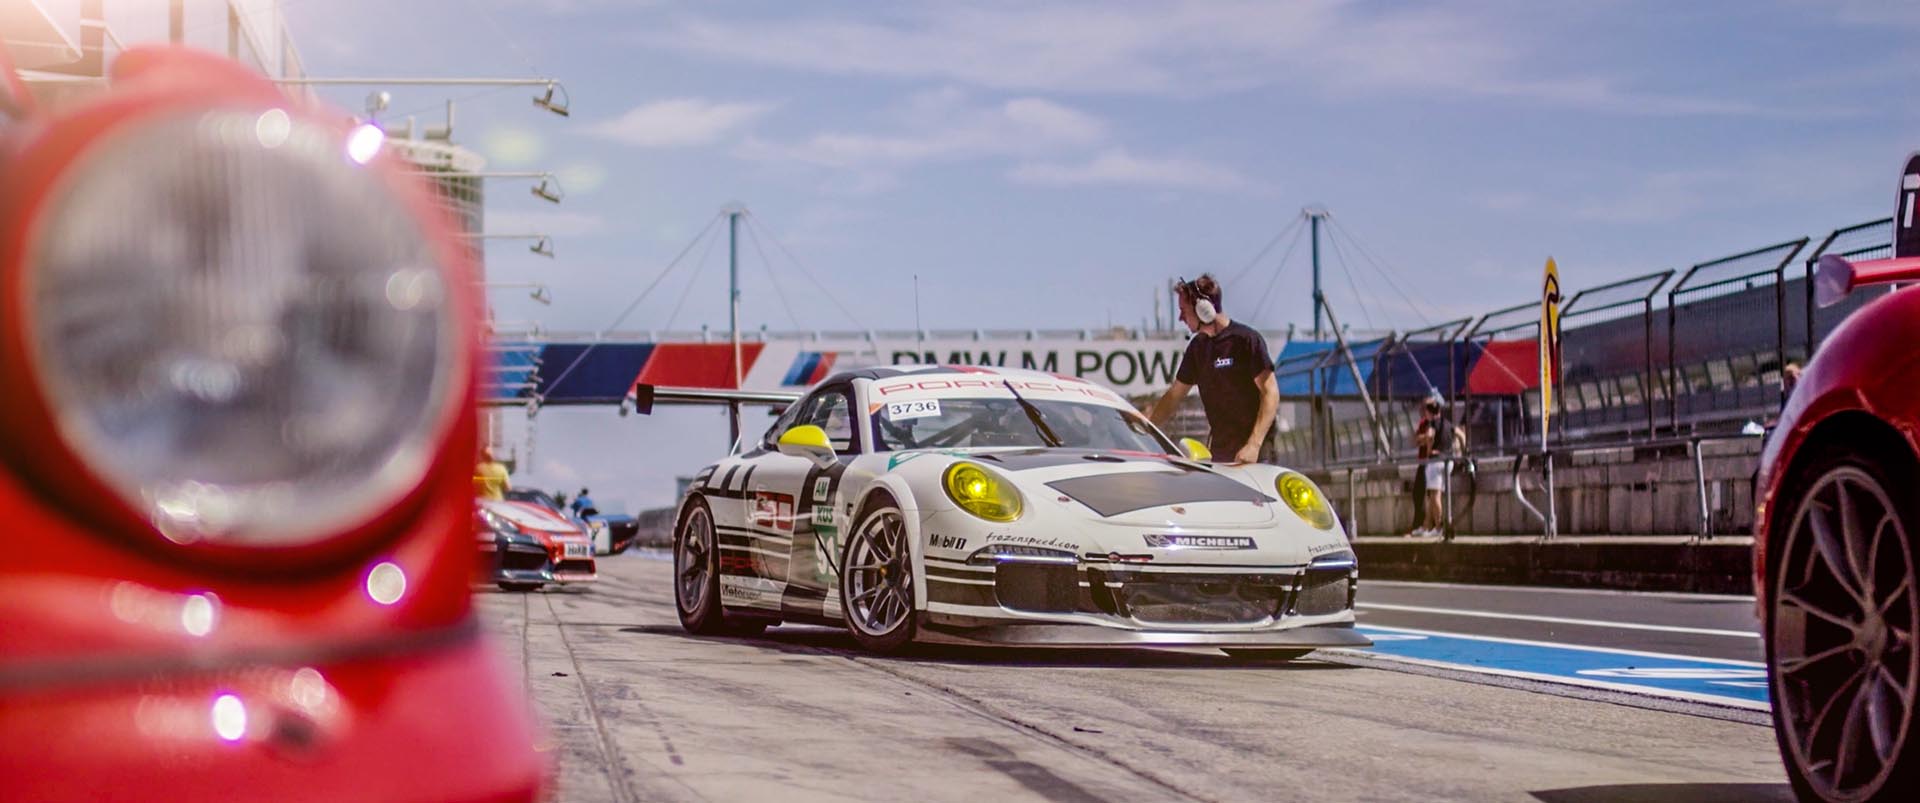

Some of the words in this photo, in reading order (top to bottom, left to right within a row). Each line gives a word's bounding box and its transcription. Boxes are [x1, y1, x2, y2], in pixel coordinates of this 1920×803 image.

[1075, 350, 1184, 385] POW
[891, 401, 937, 415] 3736
[815, 481, 828, 497] AM
[929, 534, 954, 548] Mobil
[985, 532, 1080, 550] frozenspeed.com
[1175, 537, 1250, 547] MICHELIN
